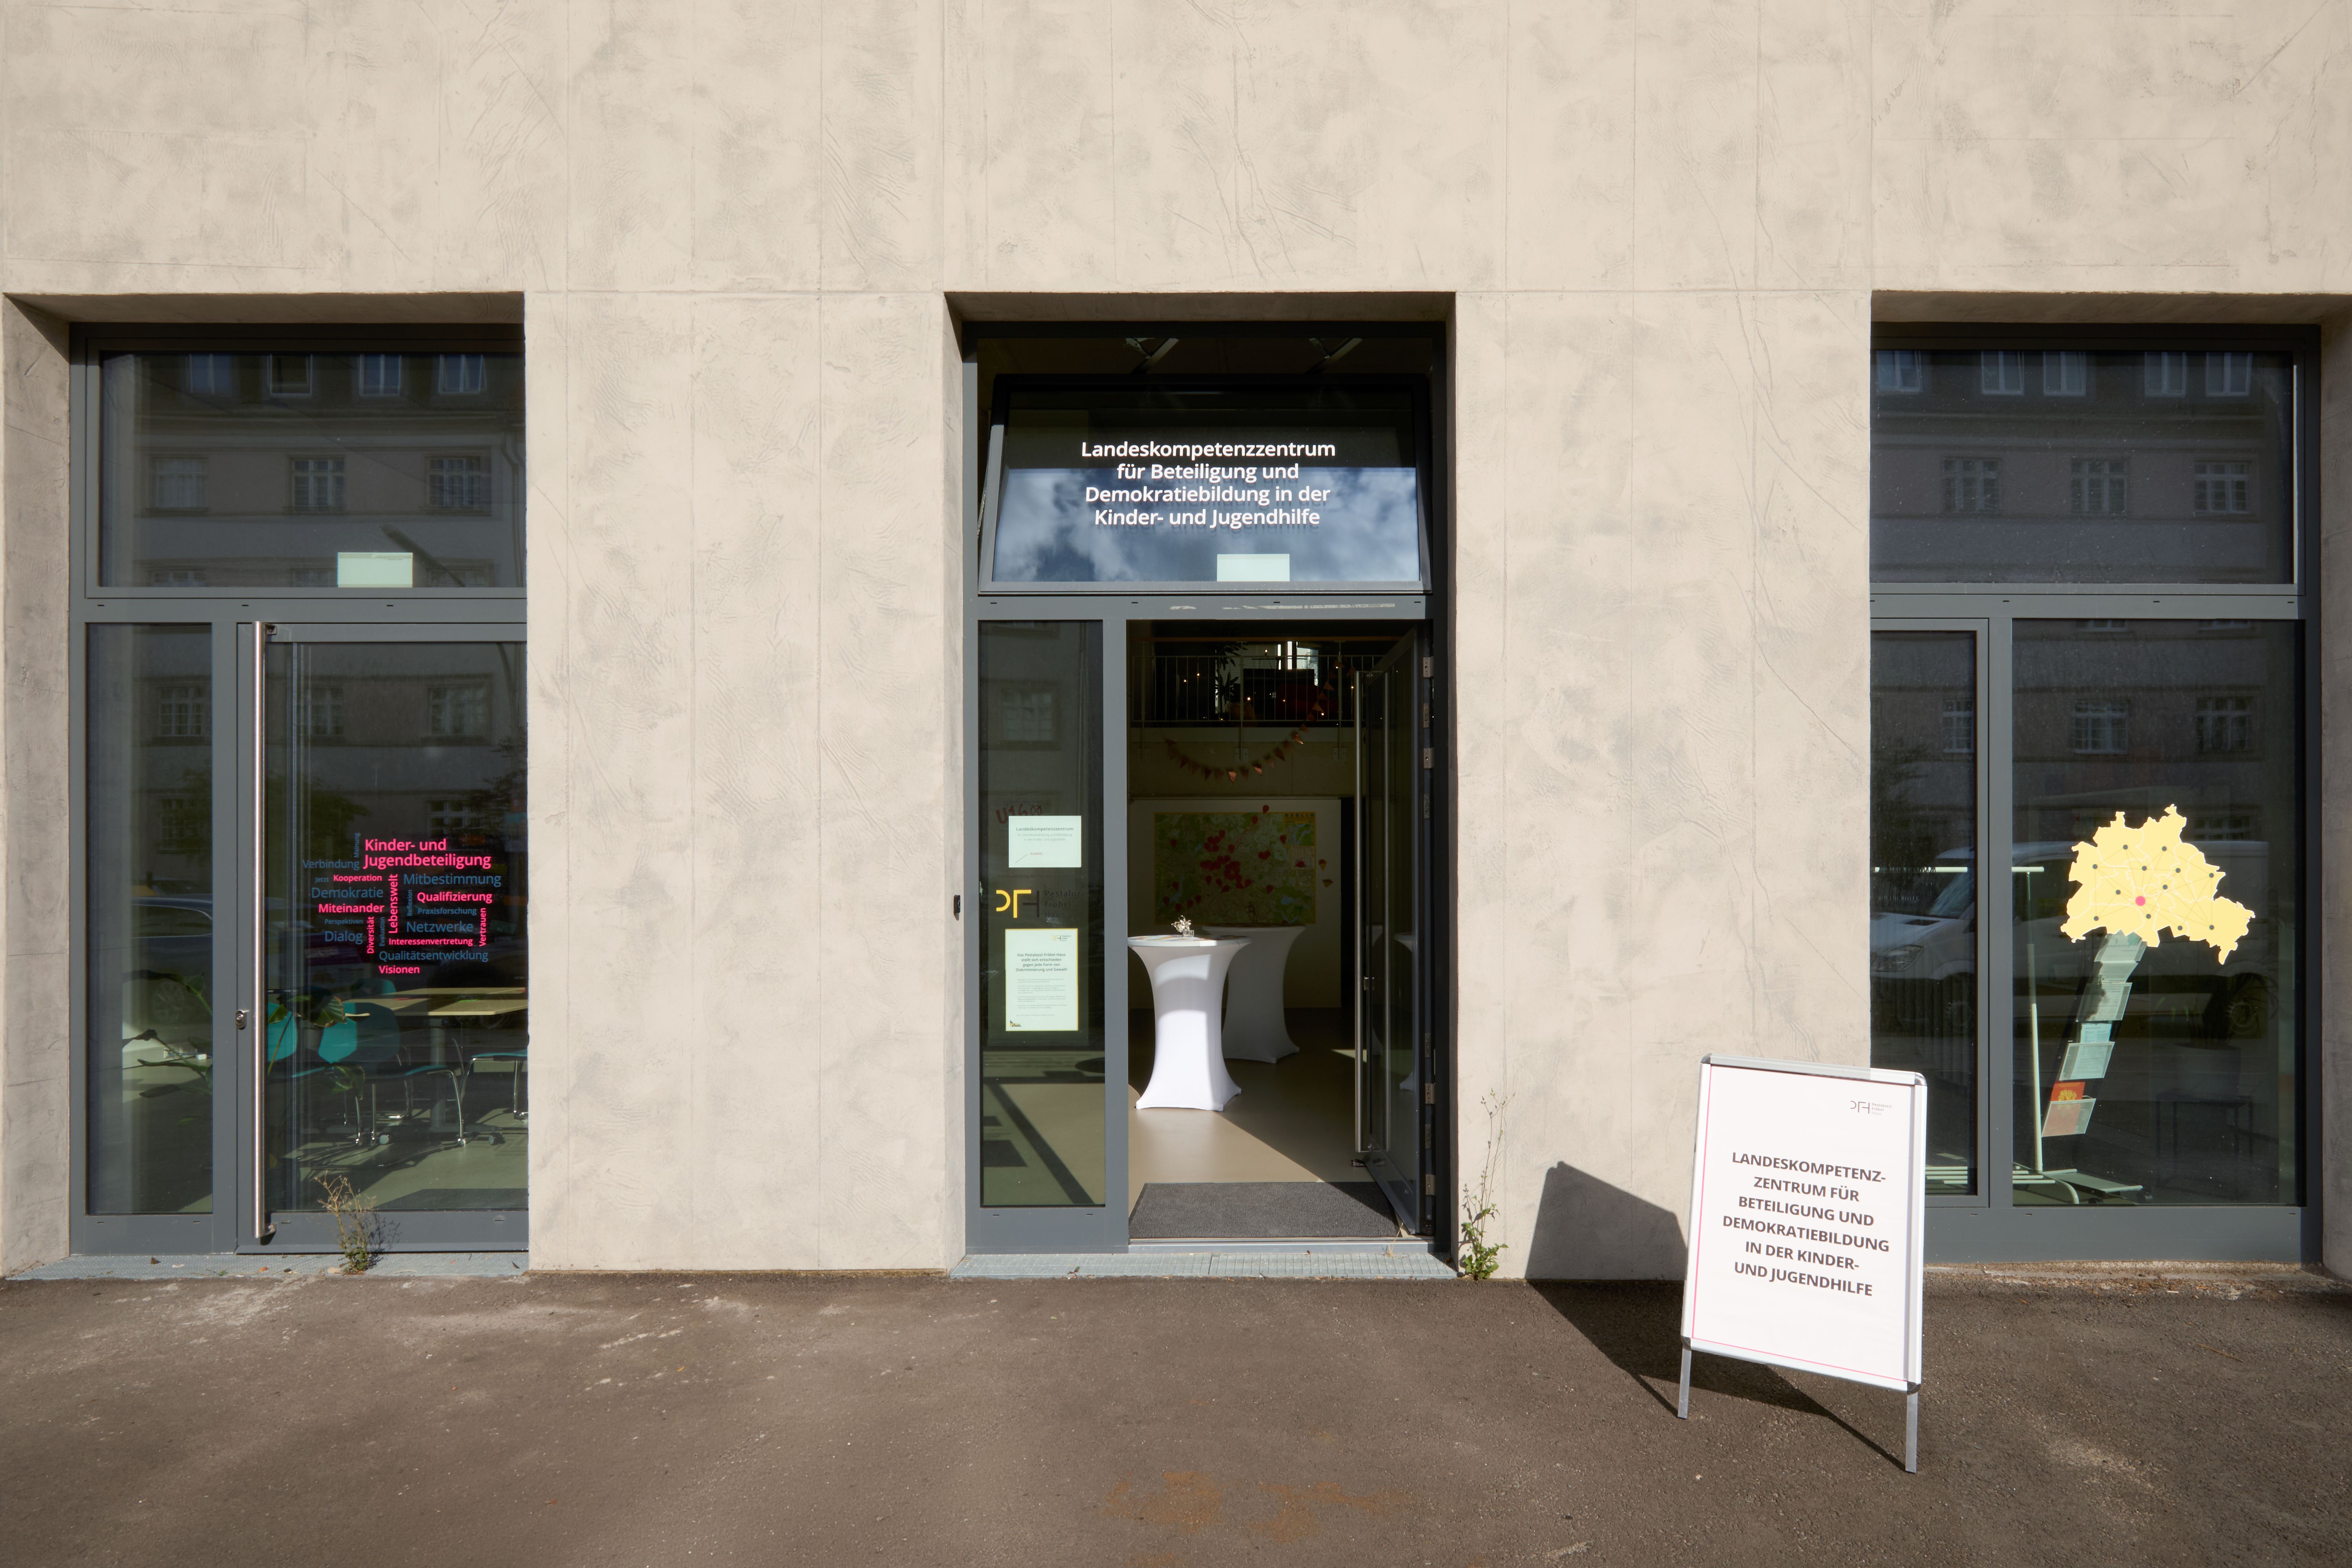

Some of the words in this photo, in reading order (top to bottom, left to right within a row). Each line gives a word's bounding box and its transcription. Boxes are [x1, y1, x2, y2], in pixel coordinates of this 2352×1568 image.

[1082, 441, 1335, 460] Landeskompetenzzentrum
[1117, 464, 1145, 478] für
[1152, 464, 1257, 483] Beteiligung
[1263, 464, 1298, 478] und
[1086, 486, 1270, 506] Demokratiebildung
[1276, 486, 1292, 501] in
[1299, 486, 1330, 501] der
[1095, 509, 1163, 525] Kinder-
[1170, 509, 1206, 524] und
[1210, 509, 1320, 529] Jugendhilfe
[365, 838, 415, 851] Kinder-
[419, 838, 447, 851] und
[302, 860, 359, 870] Verbindung
[363, 853, 491, 870] Jugendbeteiligung
[333, 874, 382, 883] Kooperation
[403, 873, 501, 888] Mitbestimmung
[311, 887, 383, 898] Demokratie
[417, 891, 493, 904] Qualifizierung
[318, 903, 384, 913] Miteinander
[388, 874, 398, 933] Lebenswelt
[416, 907, 476, 916] Praxisforschung
[366, 916, 375, 954] Diversität
[406, 921, 473, 933] Netzwerke
[479, 908, 487, 947] Vertrauen
[325, 931, 363, 944] Dialog
[389, 938, 473, 947] Interessenvertretung
[379, 950, 488, 963] Qualitätsentwicklung
[379, 965, 420, 974] Visionen
[1732, 1152, 1886, 1183] LANDESKOMPETENZ-
[1754, 1177, 1825, 1197] ZENTRUM
[1831, 1186, 1859, 1202] FÜR
[1739, 1196, 1835, 1220] BETEILIGUNG
[1840, 1211, 1874, 1226] UND
[1723, 1215, 1890, 1252] DEMOKRATIEBILDUNG
[1746, 1241, 1761, 1254] IN
[1766, 1245, 1793, 1260] DER
[1798, 1250, 1859, 1269] KINDER-
[1735, 1262, 1767, 1277] UND
[1769, 1268, 1872, 1296] JUGENDHILFE
